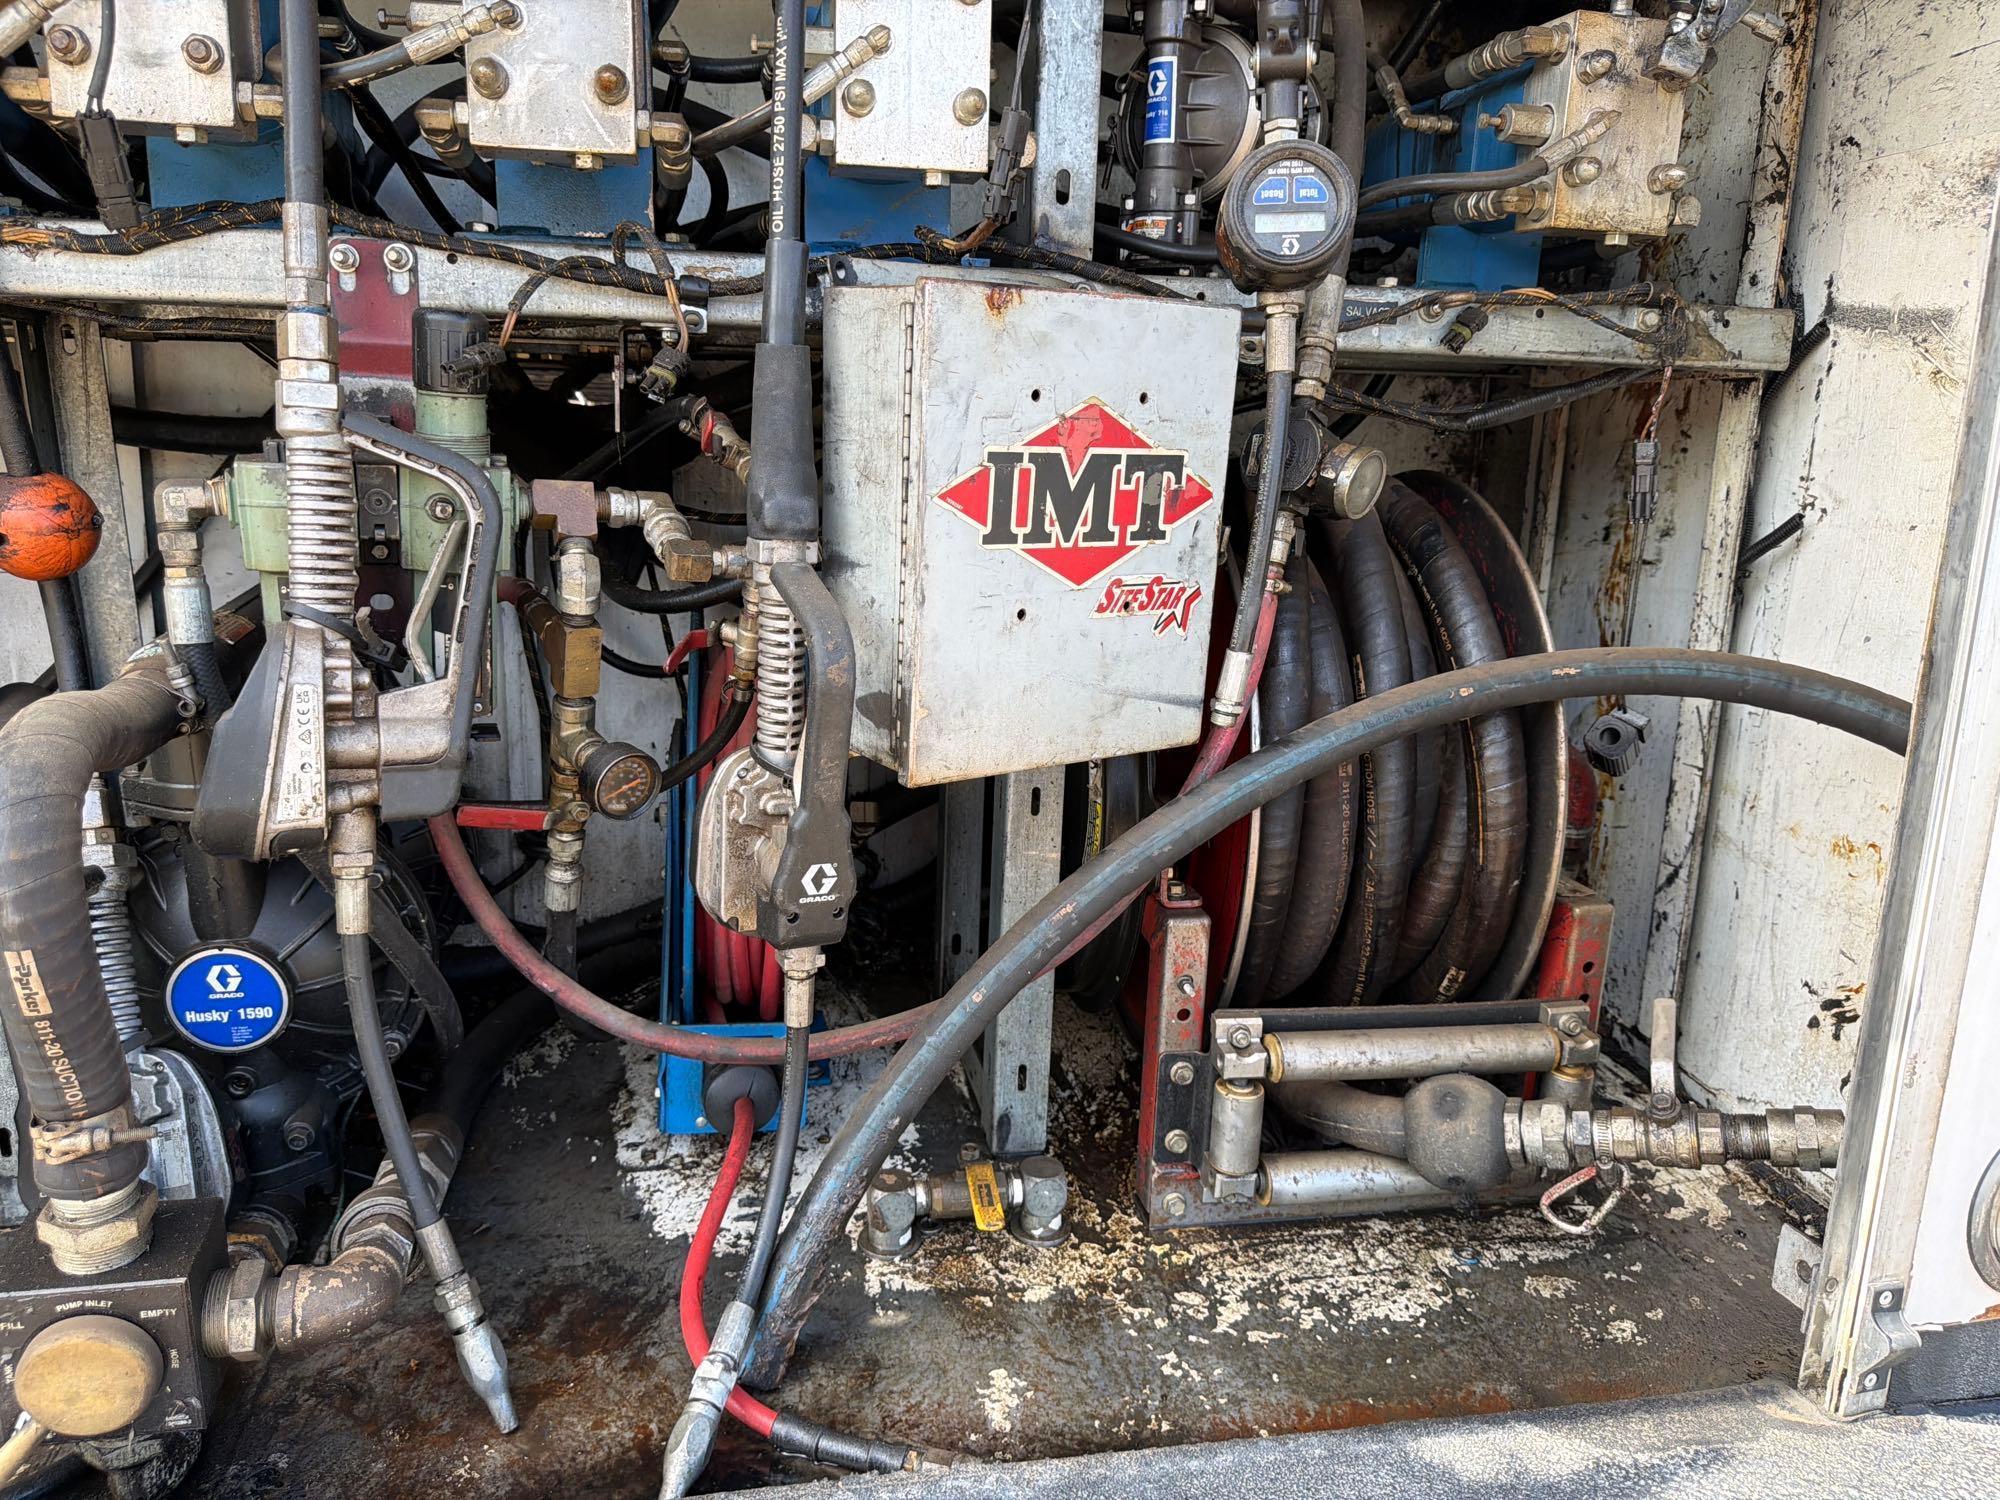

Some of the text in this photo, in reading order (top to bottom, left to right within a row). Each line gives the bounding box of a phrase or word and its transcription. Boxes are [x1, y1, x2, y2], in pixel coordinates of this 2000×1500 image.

[775, 46, 787, 81] MAX
[774, 86, 786, 112] PSI
[774, 116, 785, 152] 2750
[773, 155, 785, 201] HOSE
[1261, 188, 1319, 199] Total Reset
[772, 205, 784, 233] OIL
[1345, 305, 1391, 318] SALVA
[981, 450, 1186, 546] IMT
[297, 708, 311, 726] CE
[1366, 790, 1376, 824] HOSE
[799, 895, 836, 904] GRACO
[208, 991, 245, 999] GRACO
[185, 1006, 273, 1023] Husky 1590
[14, 955, 42, 1014] Parker
[34, 1020, 65, 1057] 811-20
[52, 1057, 88, 1110] SUCTION
[55, 1299, 113, 1312] PUMP INLET
[140, 1307, 178, 1319] EMPTY
[0, 1320, 25, 1330] FILL
[169, 1348, 180, 1369] HOSE
[3, 1363, 16, 1385] TANK
